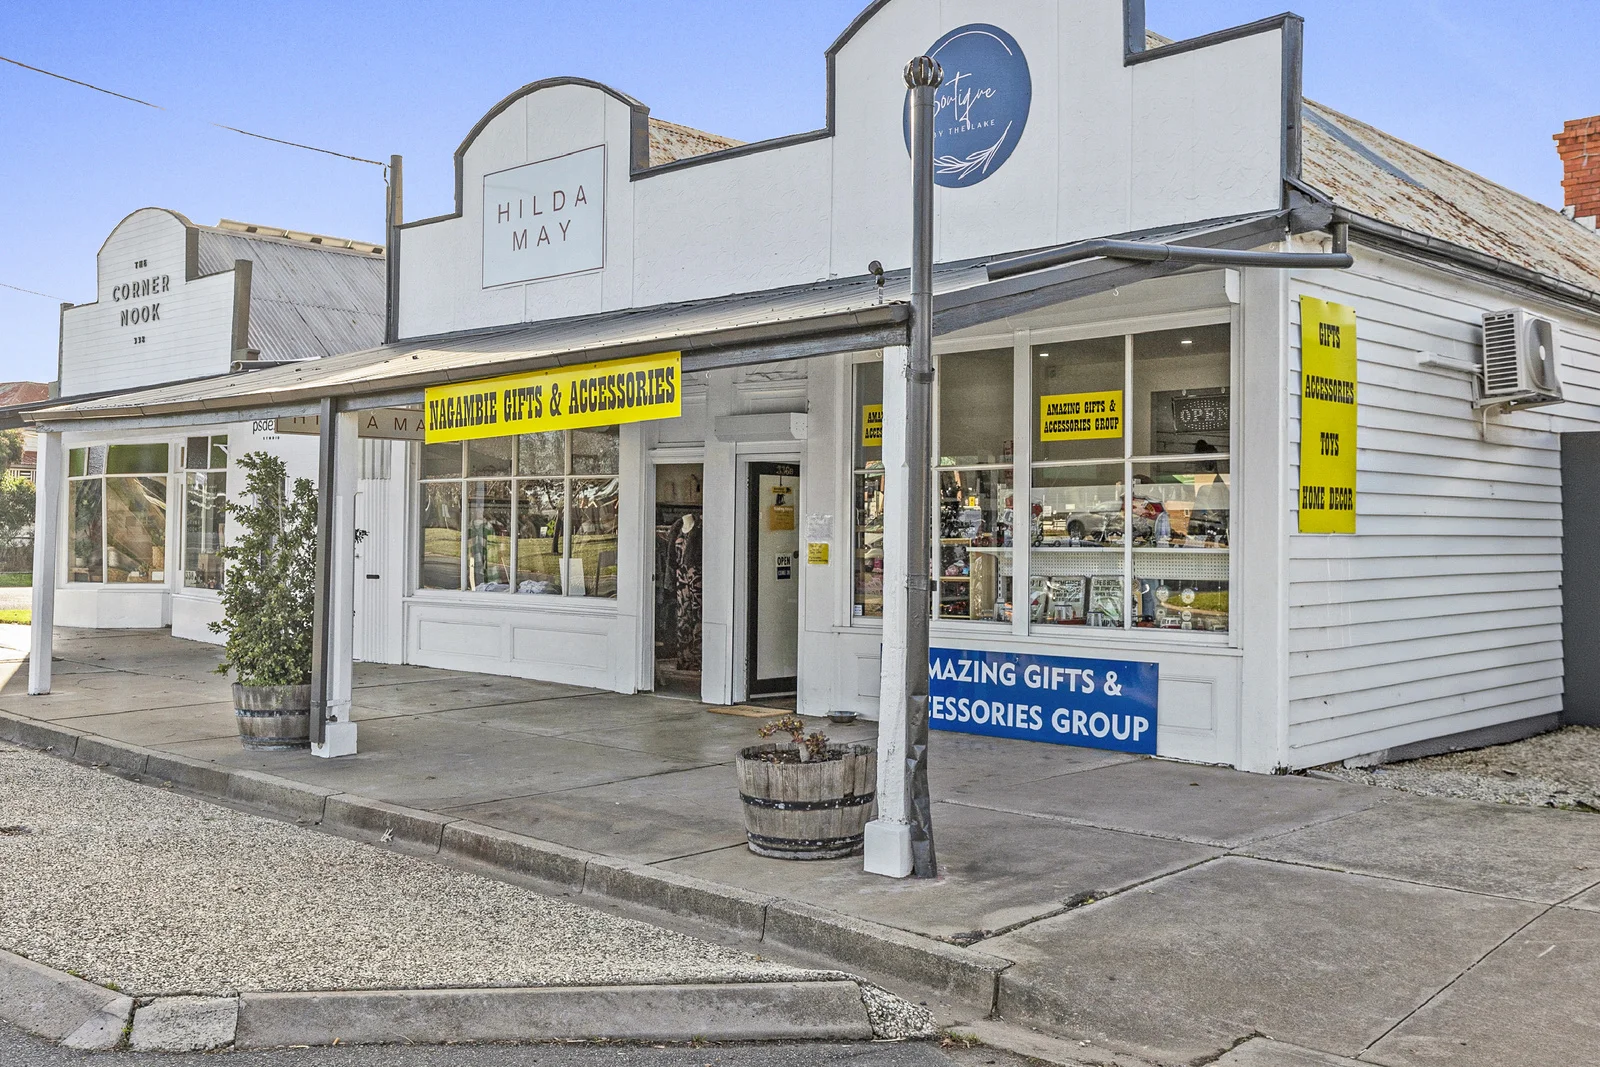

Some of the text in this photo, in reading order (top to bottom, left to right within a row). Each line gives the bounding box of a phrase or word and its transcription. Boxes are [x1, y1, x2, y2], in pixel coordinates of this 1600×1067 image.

[949, 125, 966, 135] THE
[971, 119, 995, 130] LAKE
[498, 184, 588, 224] HILDA
[512, 219, 571, 251] MAY
[134, 259, 148, 269] THE
[112, 274, 170, 302] CORNER
[120, 303, 160, 327] NOOK
[1319, 321, 1341, 349] GIFTS
[429, 366, 675, 431] NAGAMBIE GIFTS & ACCESSORIES
[1305, 374, 1354, 405] ACCESSORIES
[1046, 399, 1116, 416] AMAZING GIFTS &
[1180, 407, 1229, 423] OPEN
[394, 417, 426, 432] MA
[1044, 417, 1119, 433] ACCESSORIES GROUP
[1320, 431, 1339, 457] TOYS
[1302, 485, 1353, 511] HOME DECOR
[777, 556, 791, 566] OPEN
[928, 657, 1122, 697] MAZING GIFTS &
[928, 695, 1149, 742] ESSORIES GROUP
